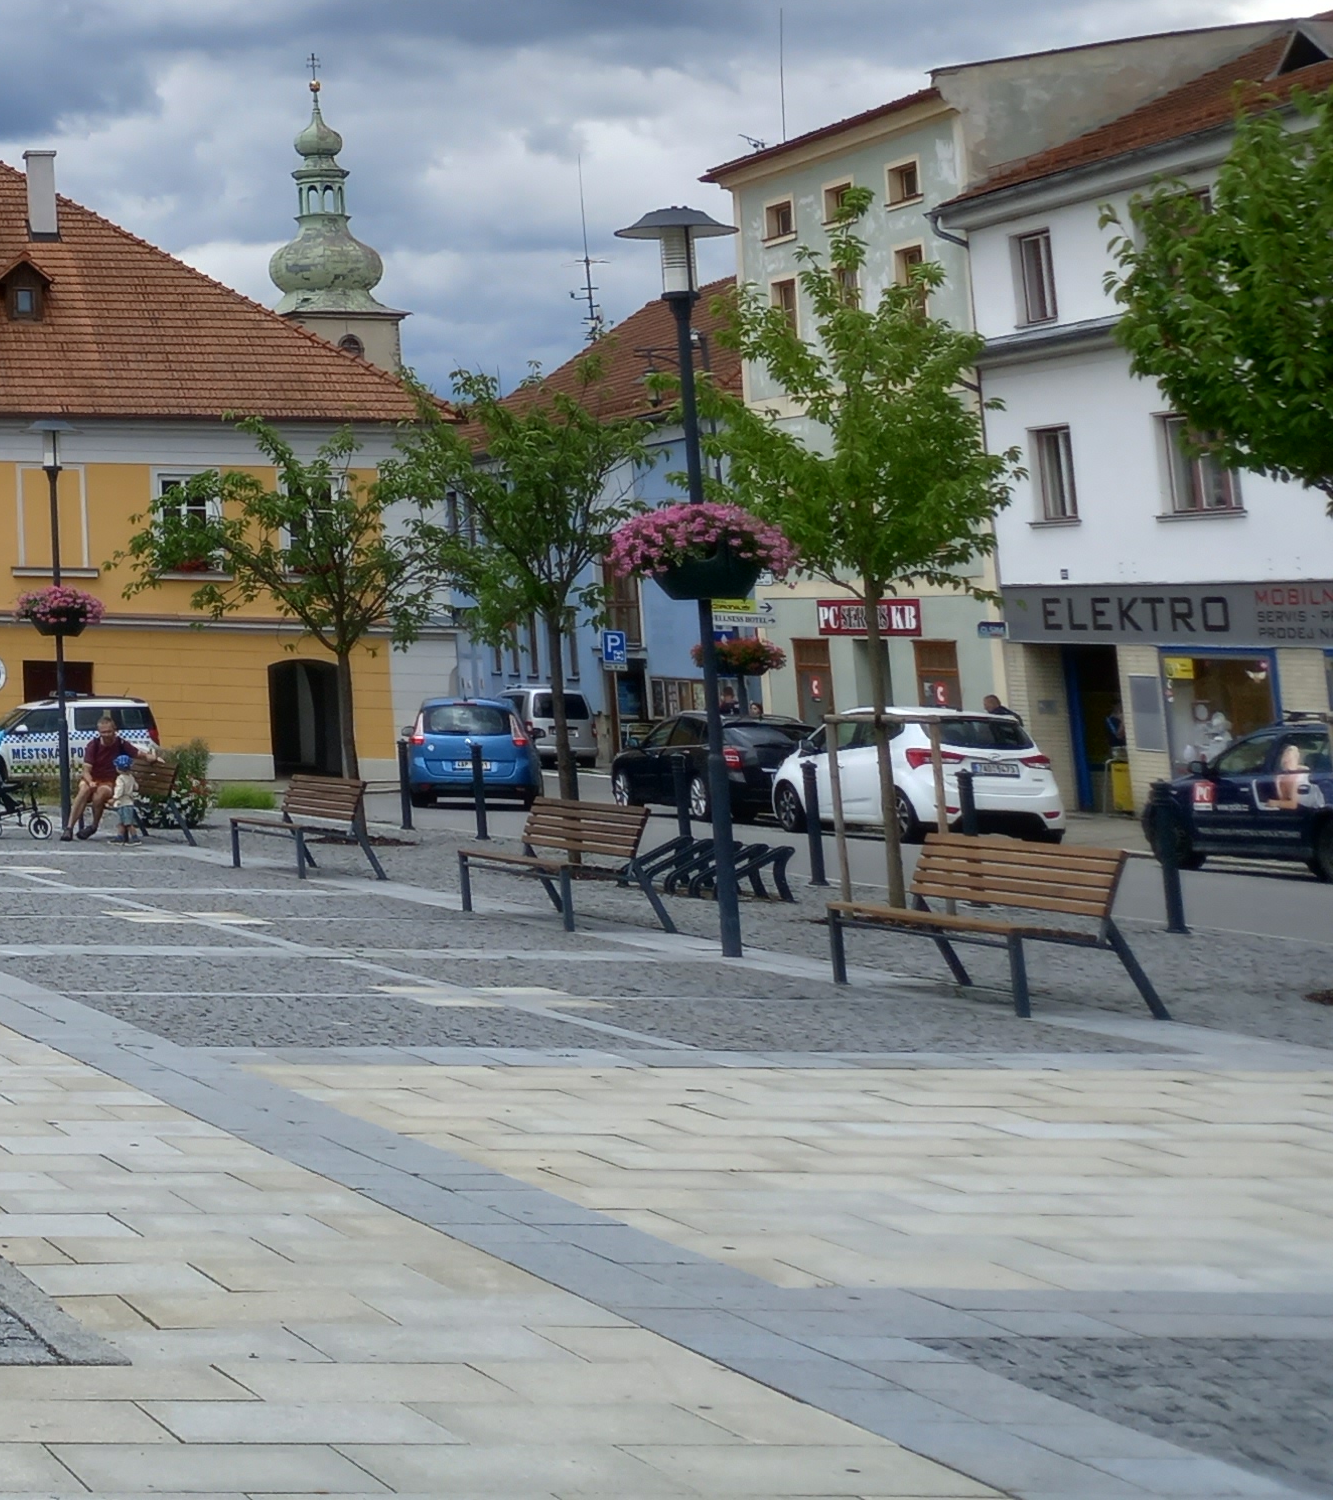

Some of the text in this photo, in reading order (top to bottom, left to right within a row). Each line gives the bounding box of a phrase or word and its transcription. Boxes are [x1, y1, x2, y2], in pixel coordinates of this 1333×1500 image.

[713, 614, 744, 622] ELLNESS
[818, 605, 917, 630] PC SERIS KB
[1041, 596, 1231, 632] ELEKTRO
[1257, 610, 1307, 622] SERVIS
[1258, 627, 1315, 639] PRODEJ
[607, 634, 621, 653] P
